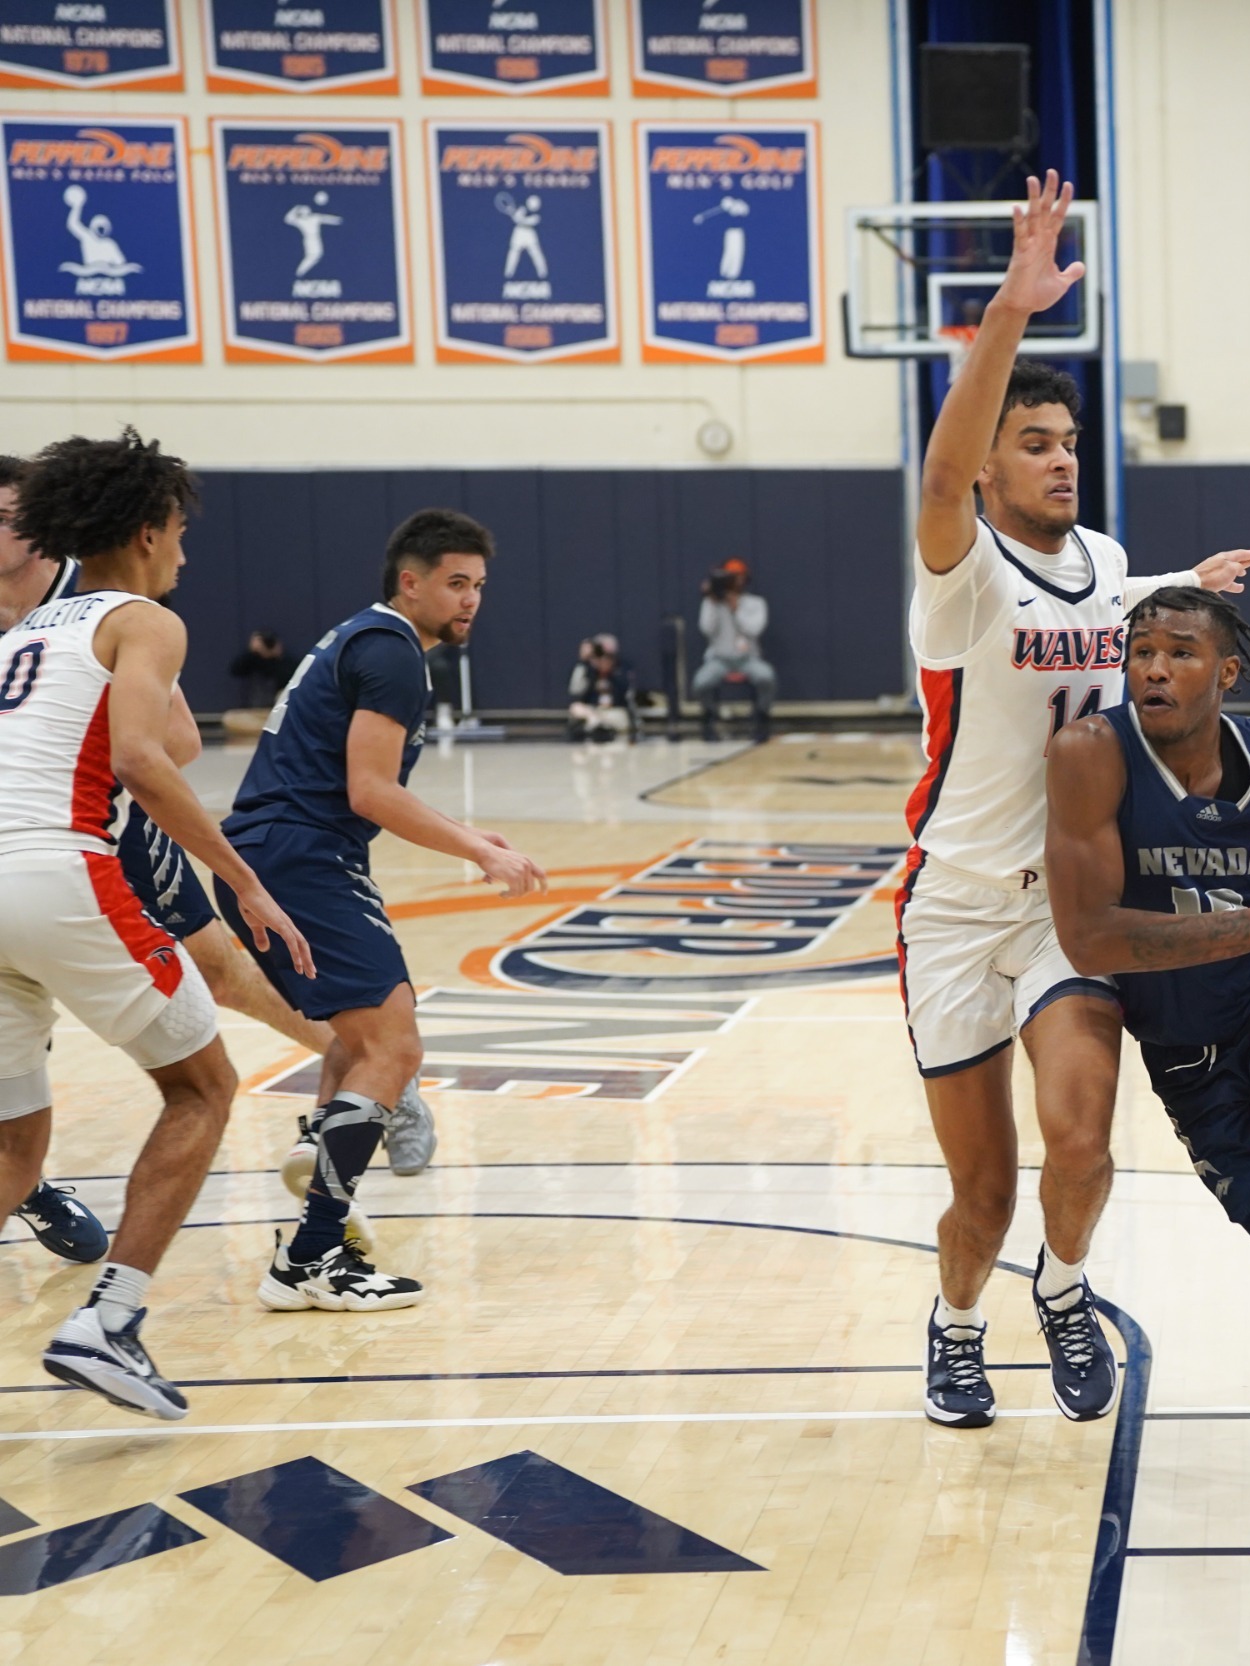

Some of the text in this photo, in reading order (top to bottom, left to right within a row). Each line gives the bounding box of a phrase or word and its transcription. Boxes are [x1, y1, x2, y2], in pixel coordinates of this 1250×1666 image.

[9, 128, 174, 168] PEPPERDINE
[228, 133, 389, 172] PEPPERDINE
[440, 133, 599, 173] PEPPERDINE
[650, 134, 806, 173] PEPPERDINE
[1011, 625, 1125, 672] WAVES
[1196, 812, 1222, 822] adidas
[1018, 869, 1039, 890] P
